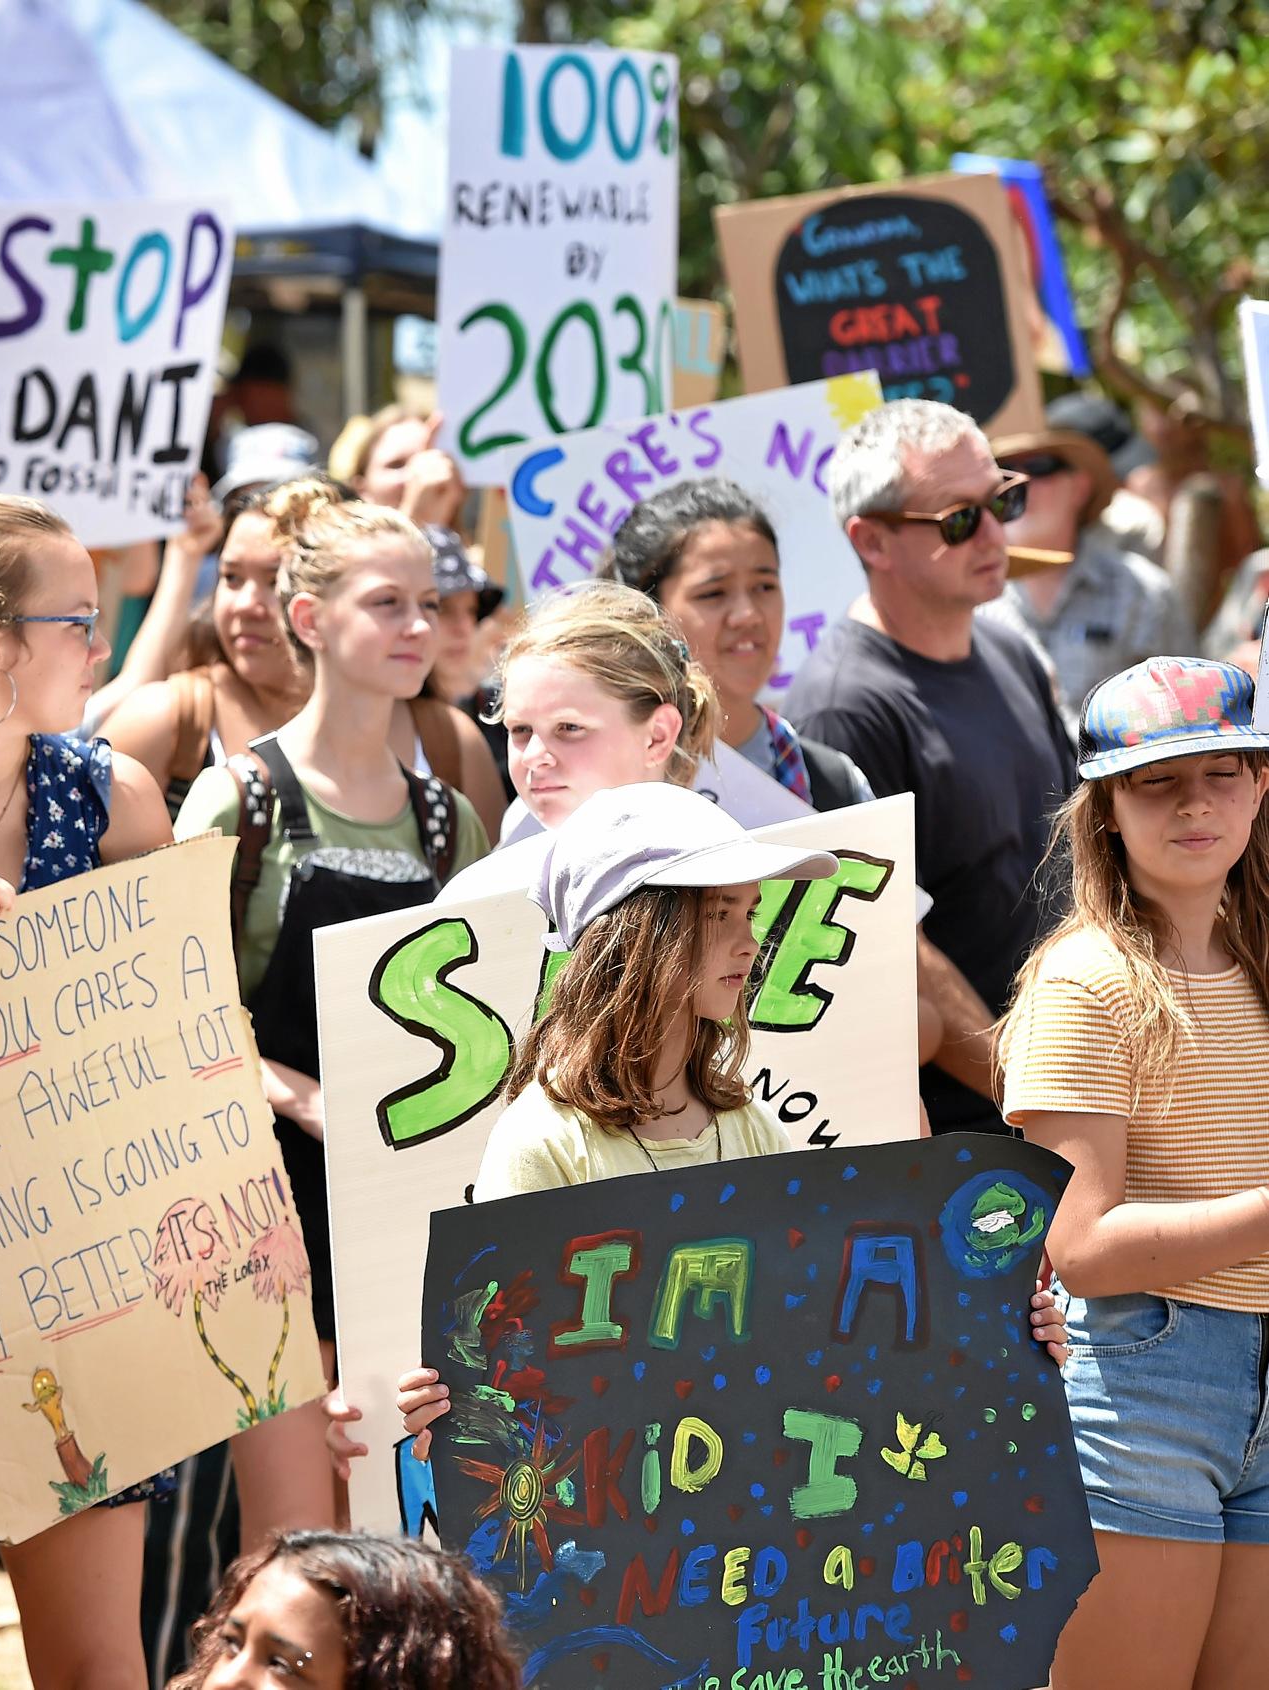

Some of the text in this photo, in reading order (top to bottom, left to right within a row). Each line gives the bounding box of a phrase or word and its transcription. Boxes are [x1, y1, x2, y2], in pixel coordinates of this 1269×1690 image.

[500, 52, 678, 164] 100%
[454, 180, 651, 229] RENEWABLE
[565, 242, 606, 284] BY
[829, 296, 941, 346] GREAT
[54, 951, 159, 1037] CARES
[182, 935, 211, 1001] A
[17, 1035, 167, 1140] AWEFUL
[177, 1004, 237, 1074] LOT
[62, 1158, 103, 1215] IS
[103, 1123, 203, 1197] GOING
[203, 1100, 251, 1157] TO
[219, 1167, 291, 1250] NOT!
[19, 1227, 164, 1332] BETTER
[205, 1254, 272, 1296] THE LORAX
[835, 1220, 924, 1350] A
[782, 1405, 866, 1522] I
[615, 1543, 789, 1625] NEED
[818, 1646, 871, 1690] the
[868, 1628, 962, 1684] earth
